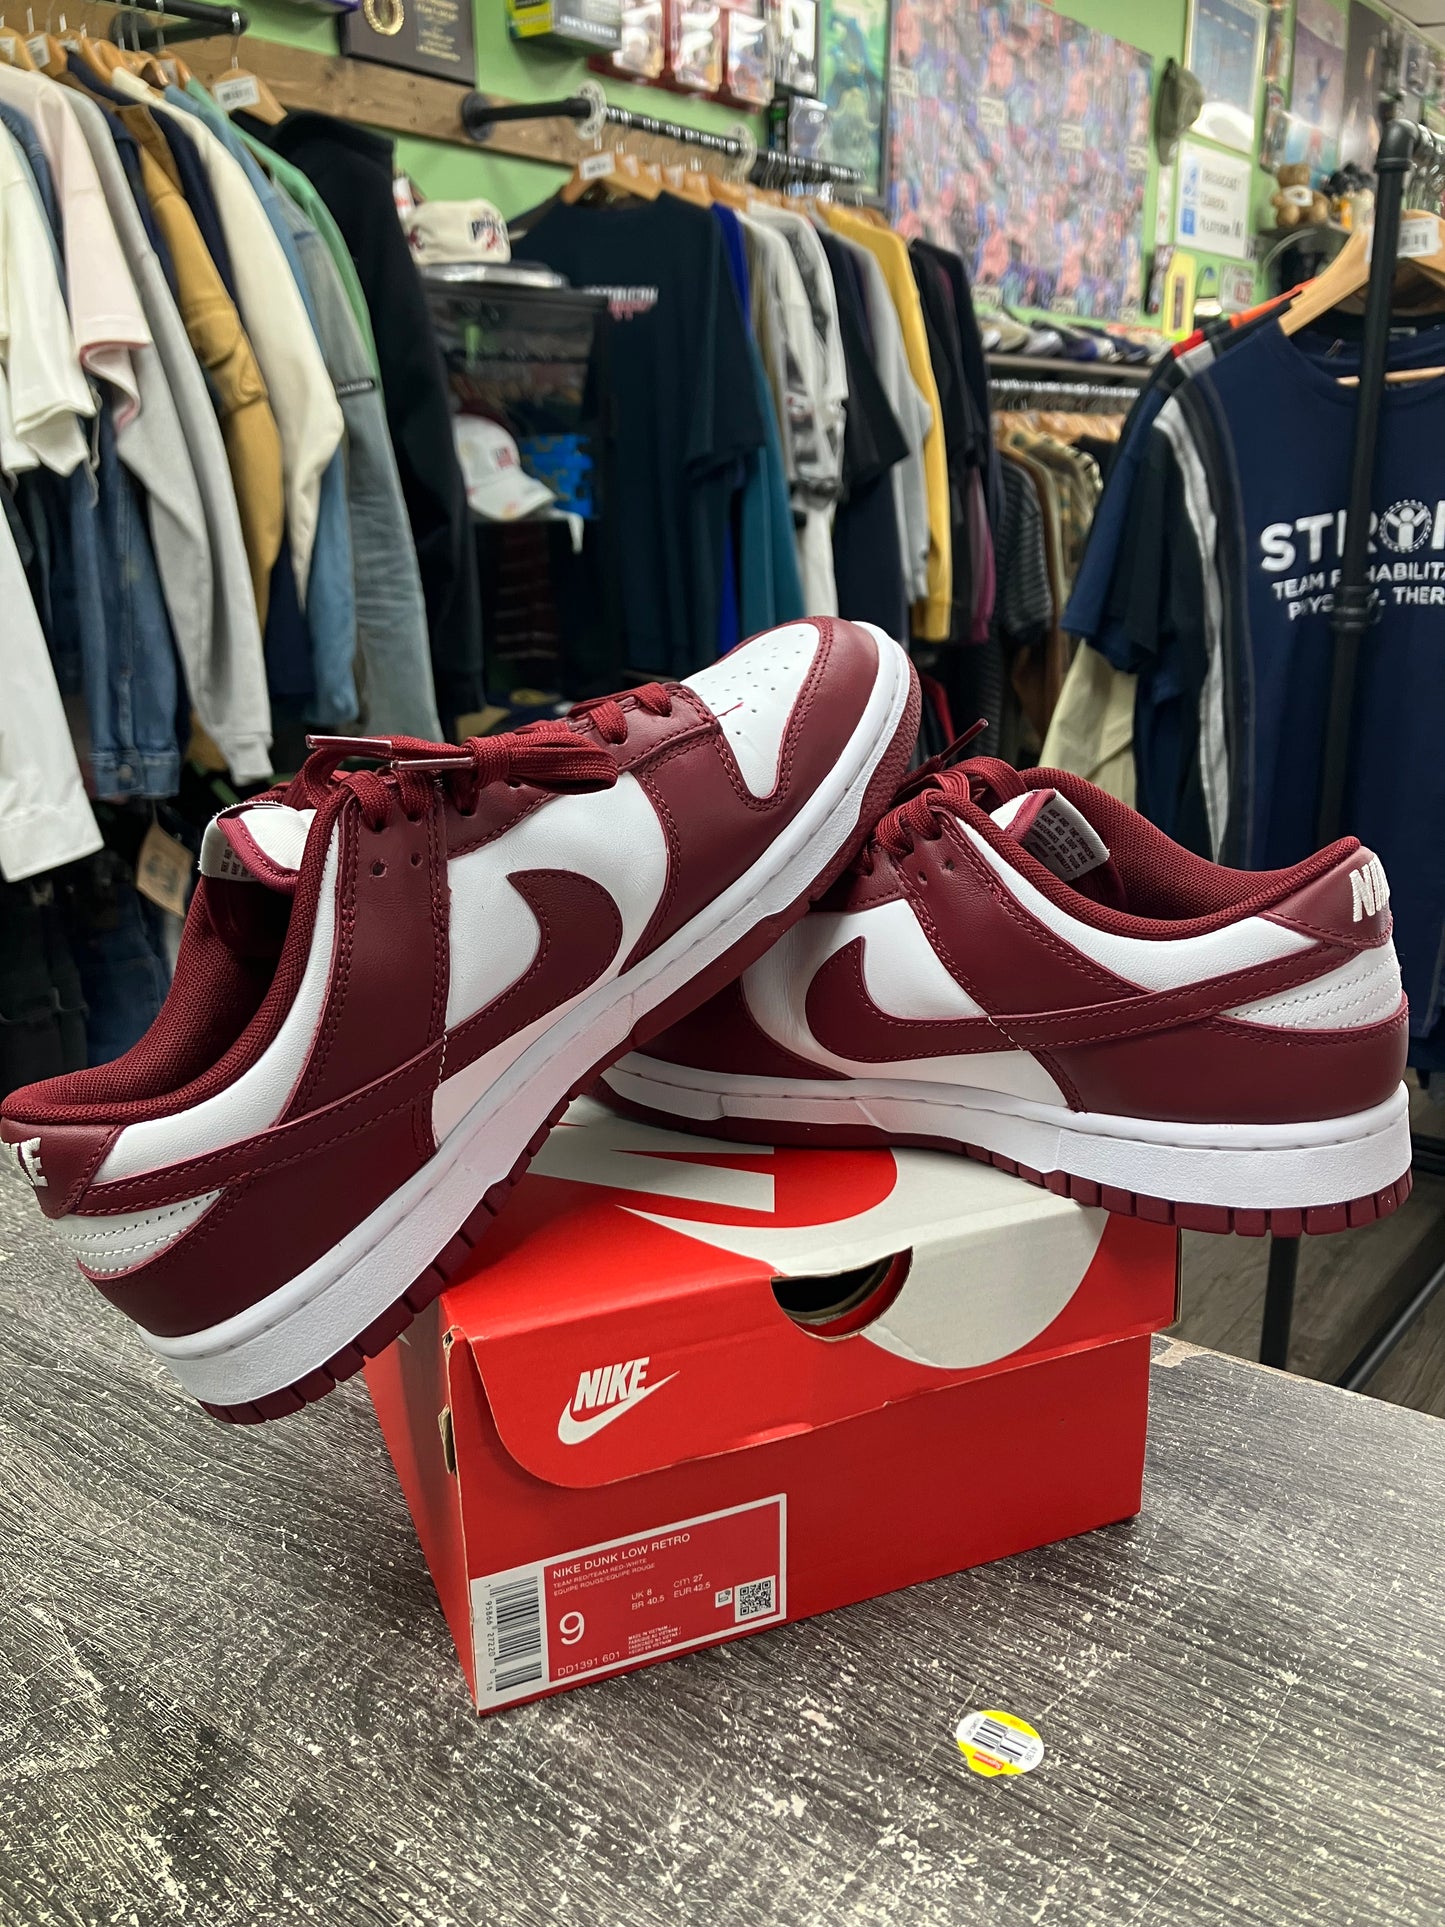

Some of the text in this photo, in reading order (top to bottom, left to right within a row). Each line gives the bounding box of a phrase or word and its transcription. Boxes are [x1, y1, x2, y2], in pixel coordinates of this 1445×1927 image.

[1272, 572, 1324, 600] TEAM
[1392, 586, 1445, 605] THER
[573, 1356, 650, 1412] NIKE
[553, 1533, 690, 1579] NIKE DUNK LOW RETRO
[554, 1579, 572, 1589] TEAM
[610, 1558, 648, 1573] RED-WHITE
[632, 1563, 656, 1574] ROUGE
[693, 1574, 703, 1583] 27
[631, 1588, 652, 1600] UK 8
[673, 1582, 711, 1598] EUR 42.5
[631, 1594, 664, 1610] BR 40.5
[559, 1611, 585, 1645] 9
[558, 1651, 620, 1676] DD1391 601
